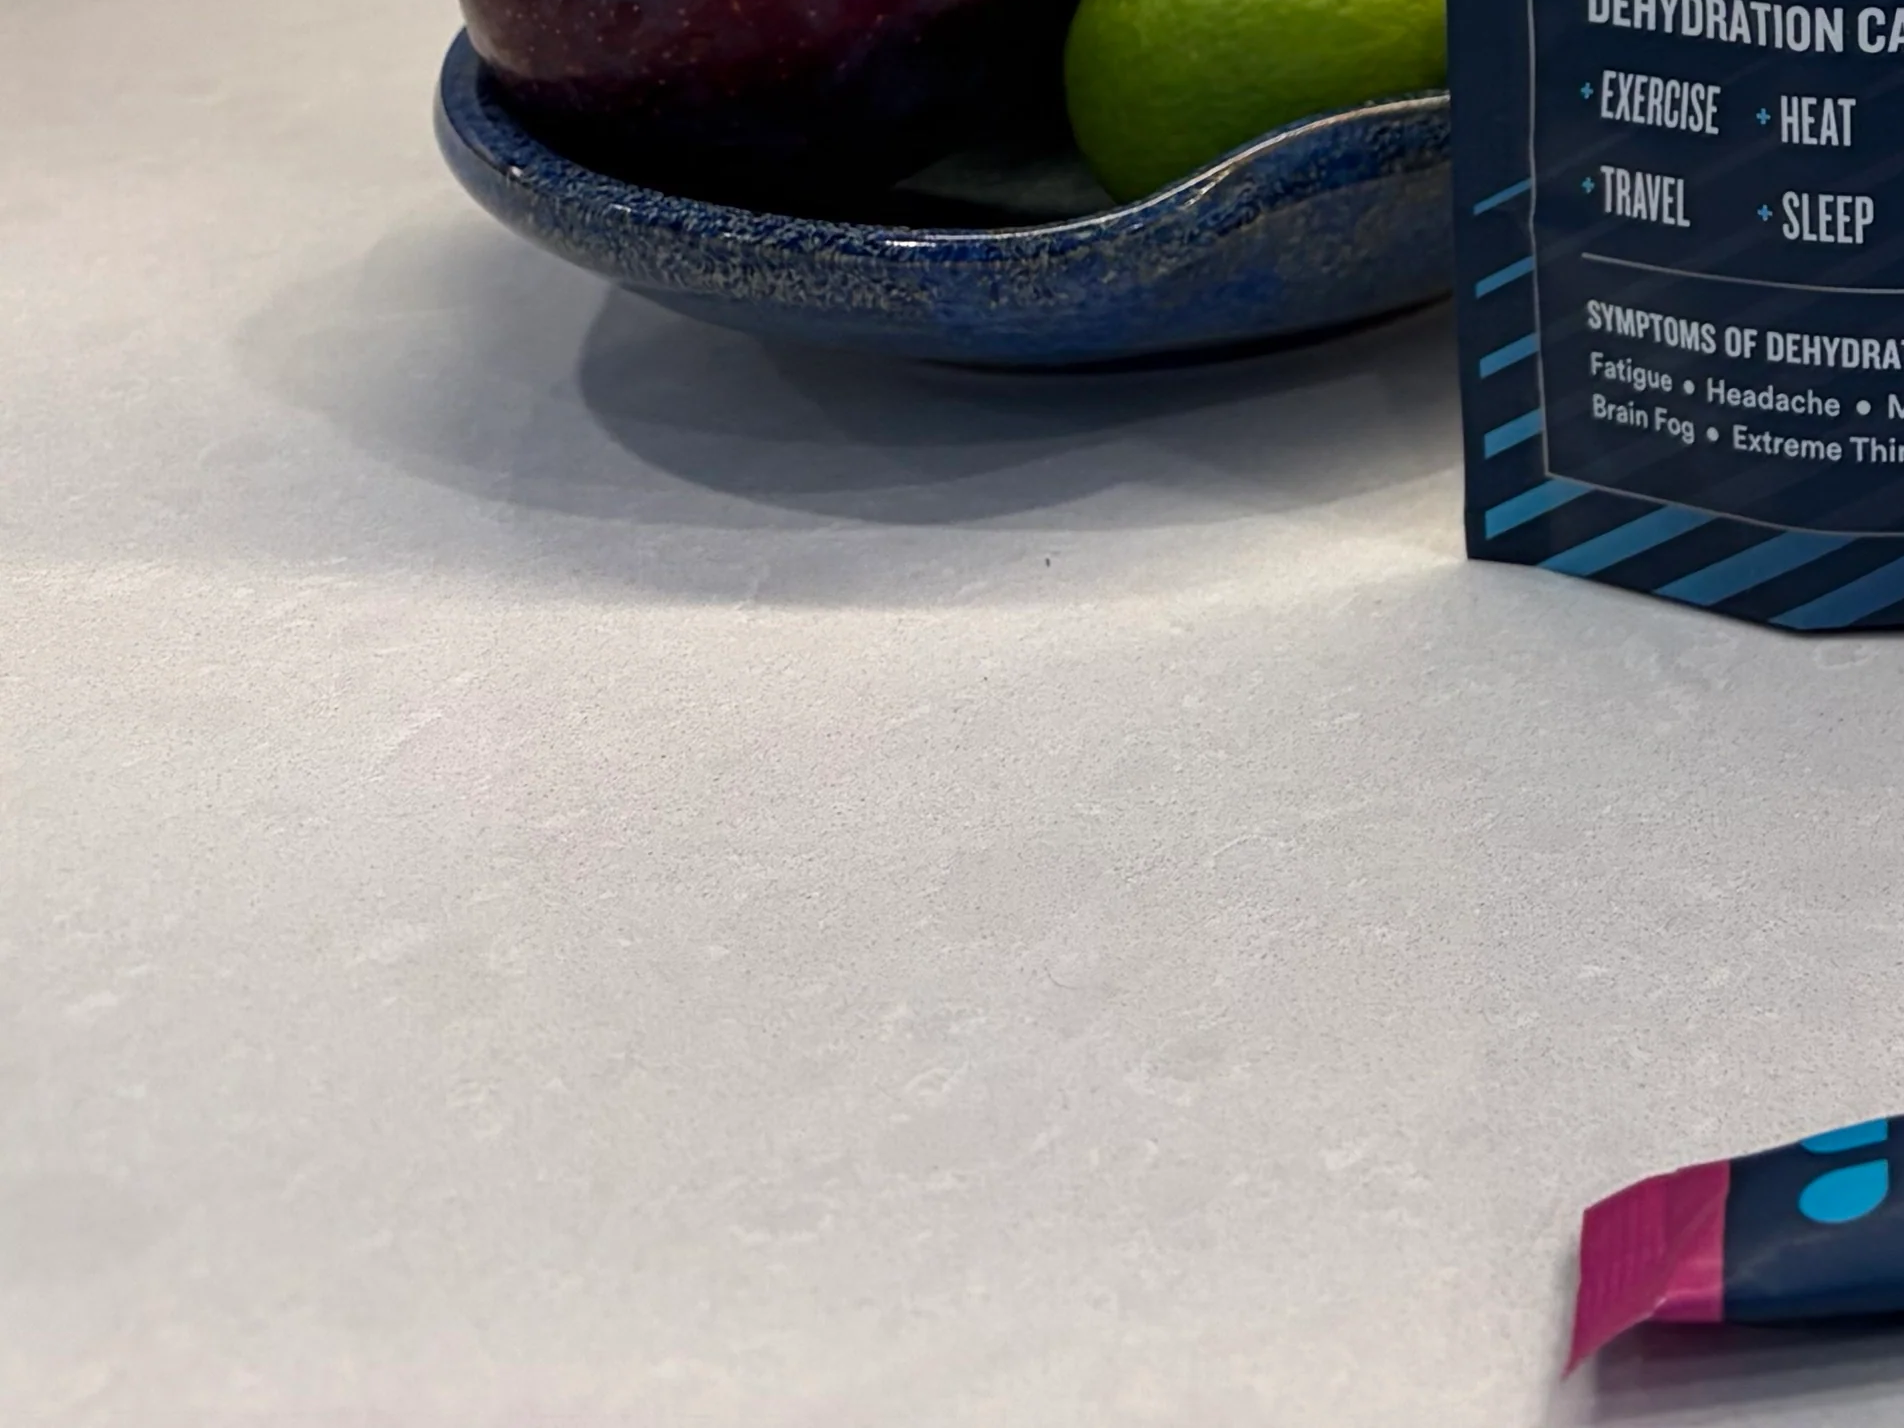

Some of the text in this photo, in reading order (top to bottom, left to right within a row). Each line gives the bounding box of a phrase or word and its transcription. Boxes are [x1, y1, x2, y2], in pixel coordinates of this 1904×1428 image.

[1600, 69, 1721, 135] EXERCISE
[1780, 95, 1856, 146] HEAT
[1600, 166, 1690, 227] TRAVEL
[1782, 191, 1874, 244] SLEEP
[1586, 299, 1717, 354] SYMPTOMS
[1724, 325, 1758, 359] OF
[1590, 352, 1673, 393] Fatigue
[1706, 378, 1841, 417] Headache
[1592, 394, 1648, 428] Brain
[1654, 407, 1695, 444] Fog
[1733, 424, 1842, 461] Extreme
